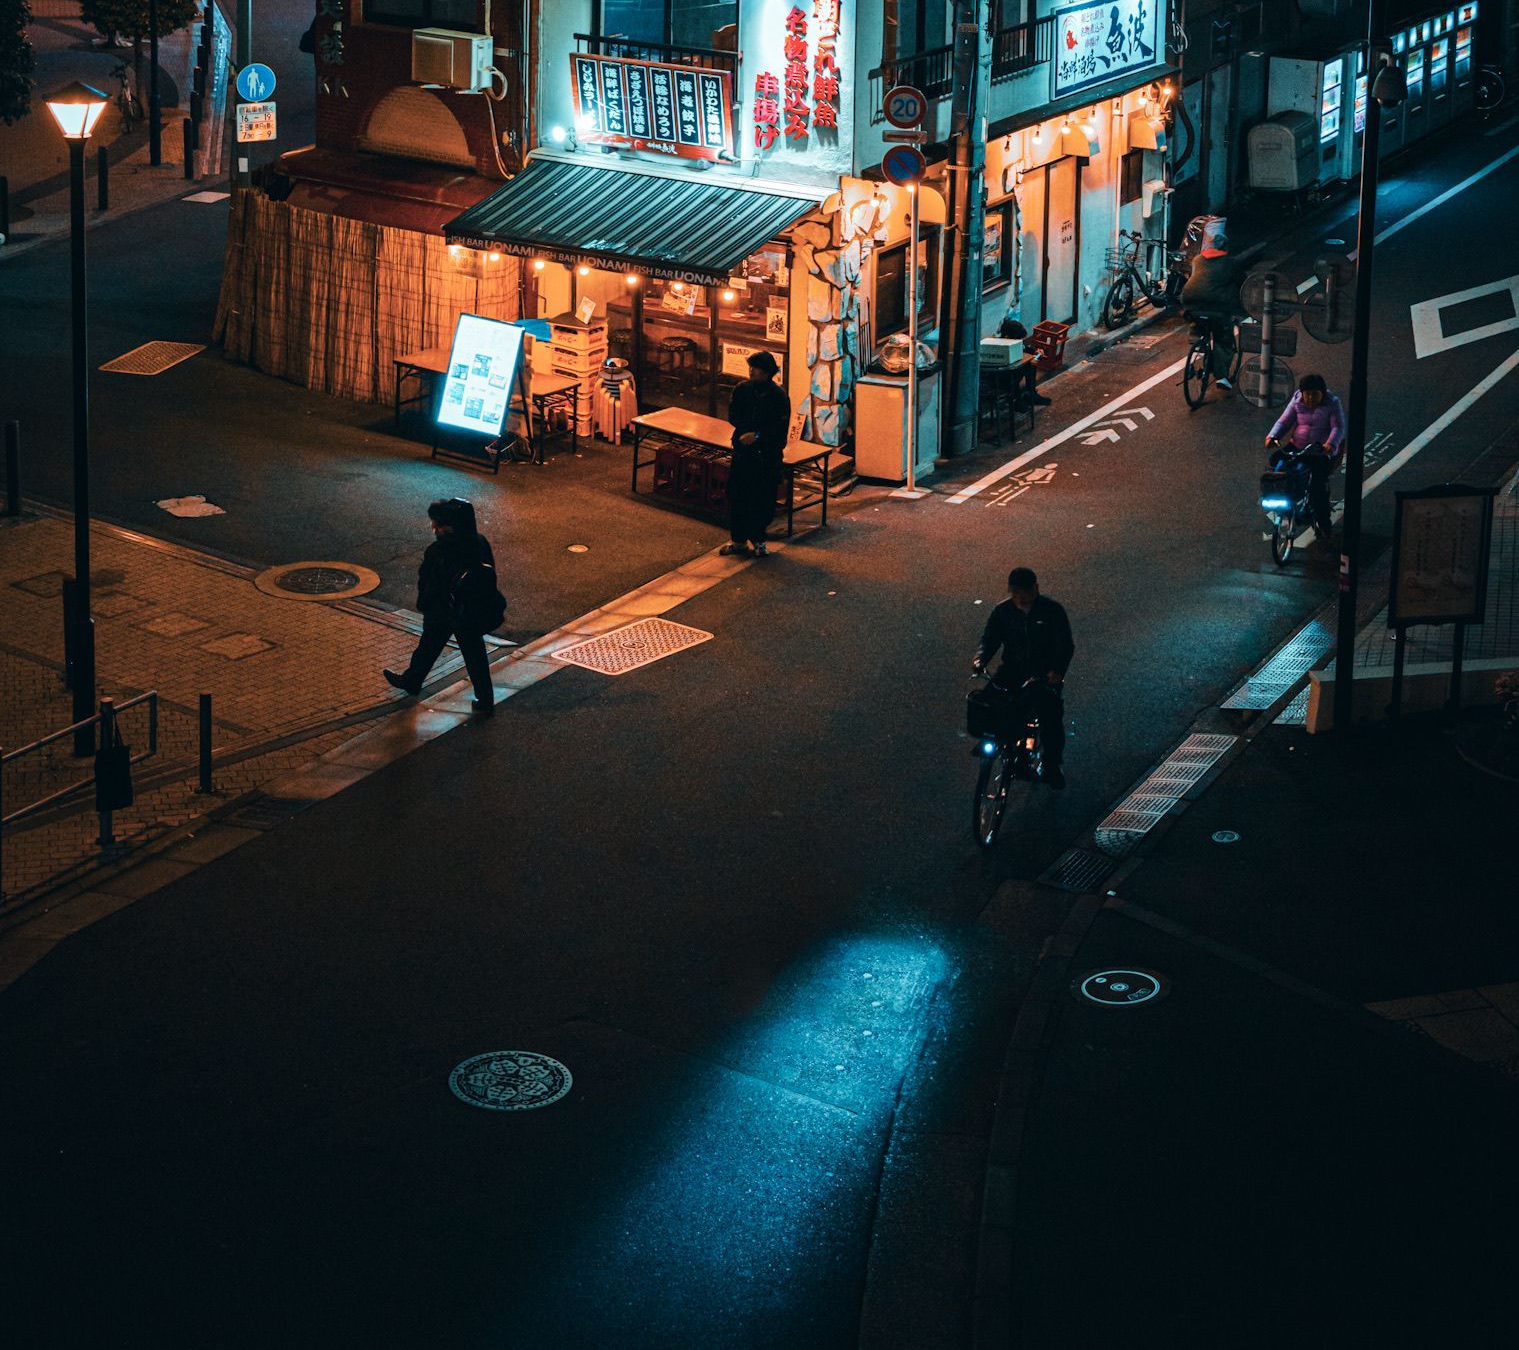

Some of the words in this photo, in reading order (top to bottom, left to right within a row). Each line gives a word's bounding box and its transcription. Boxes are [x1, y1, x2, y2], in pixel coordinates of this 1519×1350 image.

[1096, 0, 1154, 69] 魚波
[582, 63, 598, 129] しじみラー
[783, 5, 810, 140] 名物煮込み
[680, 80, 696, 137] 海老餃子
[753, 71, 780, 150] 串揚げ
[892, 99, 917, 118] 20
[467, 237, 483, 247] BAR
[485, 239, 534, 257] UONAMI
[559, 253, 576, 263] BAR
[577, 254, 631, 273] UONAMI
[633, 265, 651, 275] FISH
[655, 268, 673, 278] BAR
